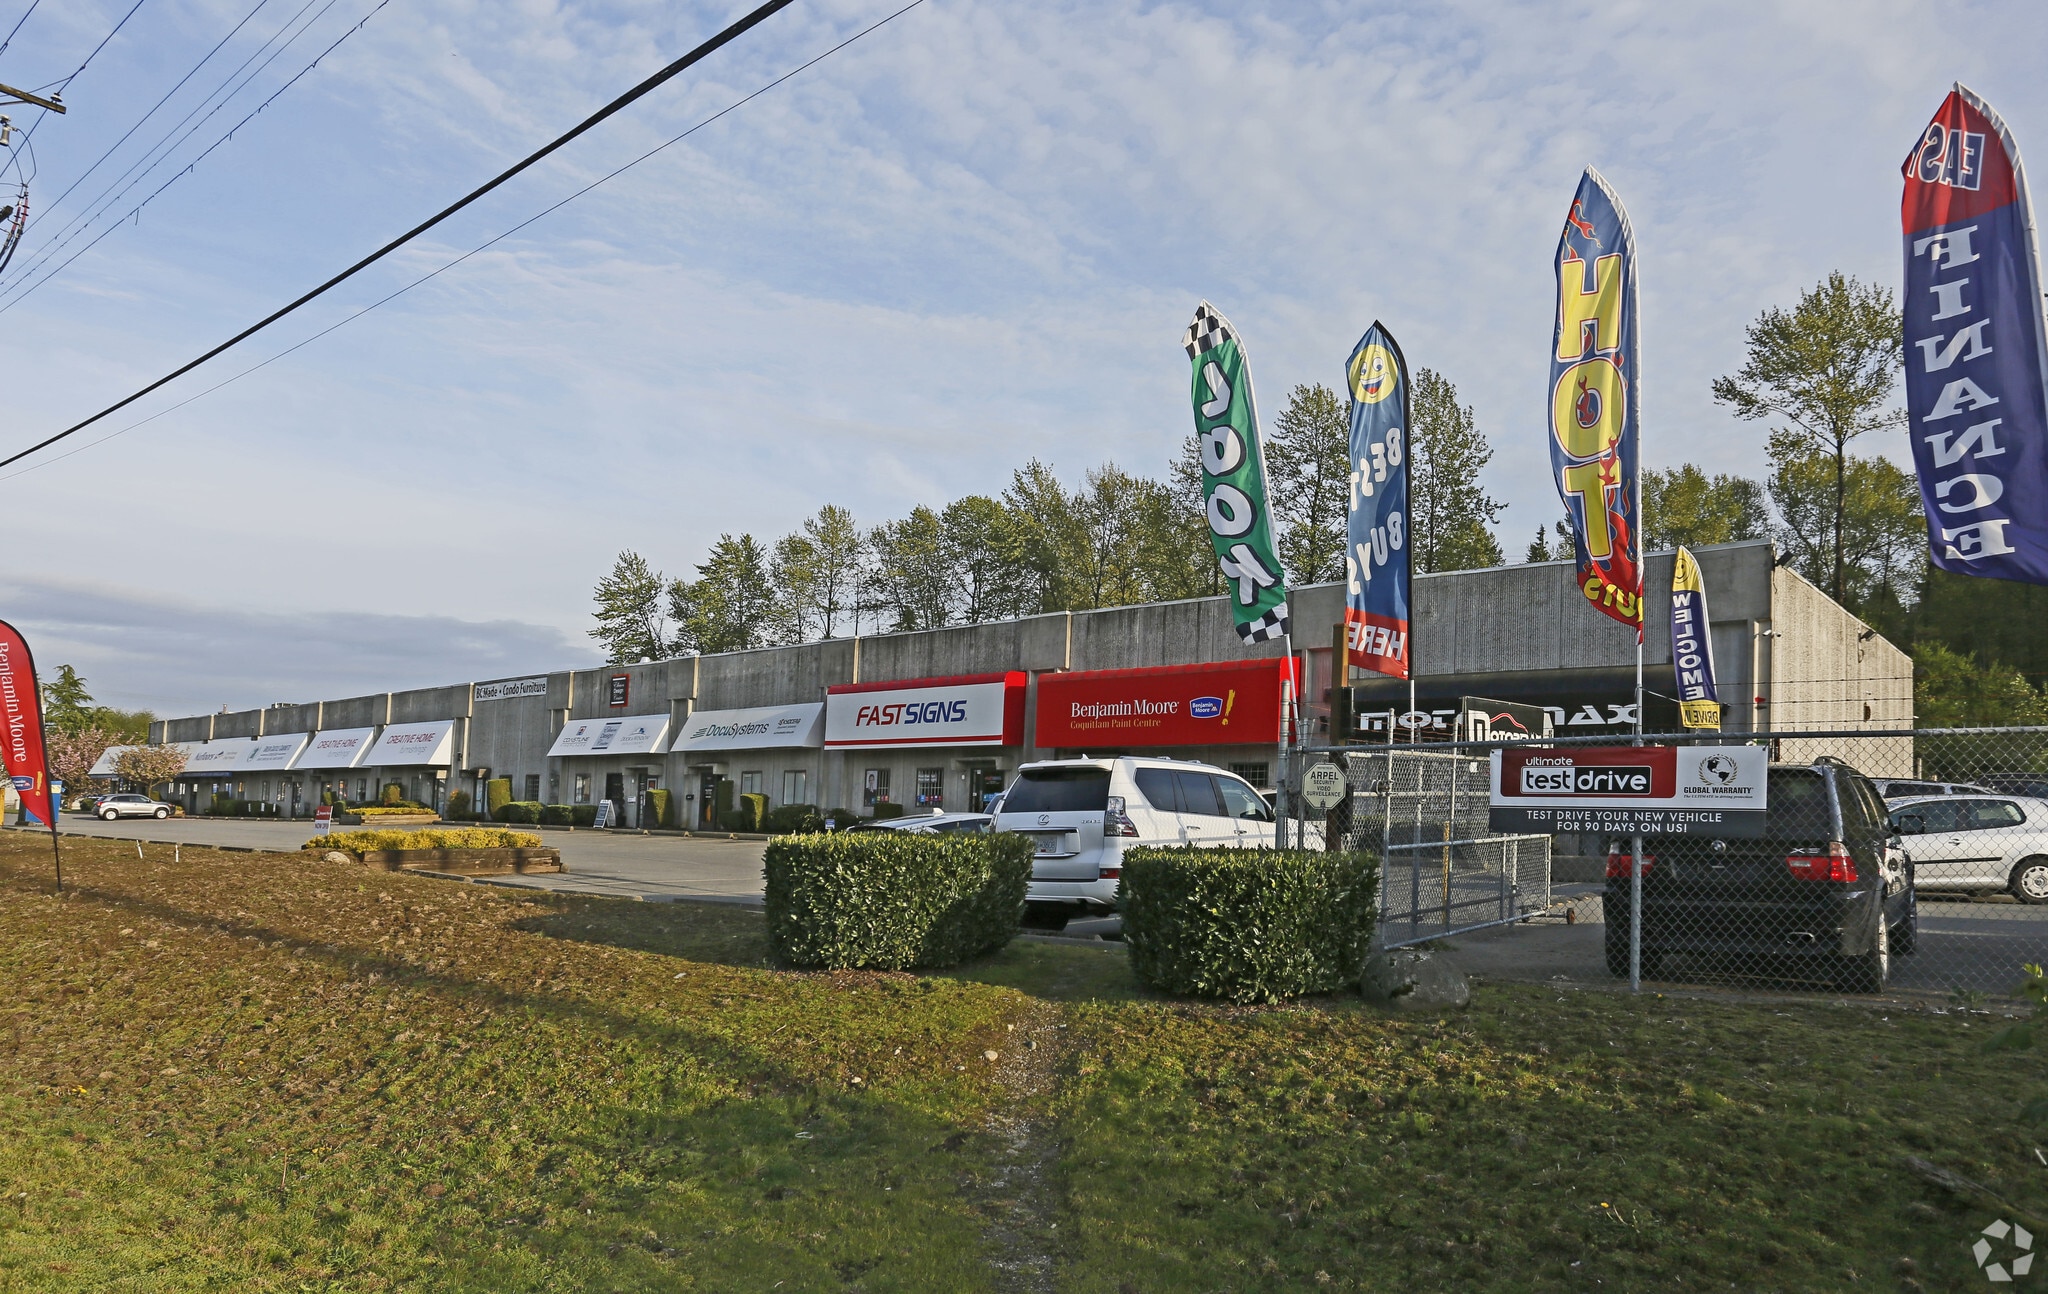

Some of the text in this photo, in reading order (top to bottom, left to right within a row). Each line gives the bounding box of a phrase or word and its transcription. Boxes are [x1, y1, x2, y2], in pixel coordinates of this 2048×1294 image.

[1553, 252, 1627, 561] HOT
[502, 683, 519, 696] Condo
[520, 681, 546, 694] Furniture
[1071, 699, 1178, 720] Benjamin Moore
[1192, 702, 1213, 710] Benjamin
[856, 700, 967, 726] FASTSIGNS
[706, 722, 769, 739] DocuSystems
[1070, 718, 1161, 731] Coquitlam Paint Centre
[10, 713, 27, 763] Moore
[317, 739, 358, 749] CREATIVE HOME
[386, 733, 435, 744] CREATIVE HOME
[1525, 757, 1573, 767] ultimate
[1310, 771, 1338, 780] ARPEL
[1525, 770, 1647, 791] test drive
[1683, 786, 1751, 794] GLOBAL WARRANTY
[1527, 810, 1722, 822] TEST DRIVE YOUR NEW VEHICLE
[1557, 821, 1688, 833] FOR 90 DAYS ON US!
